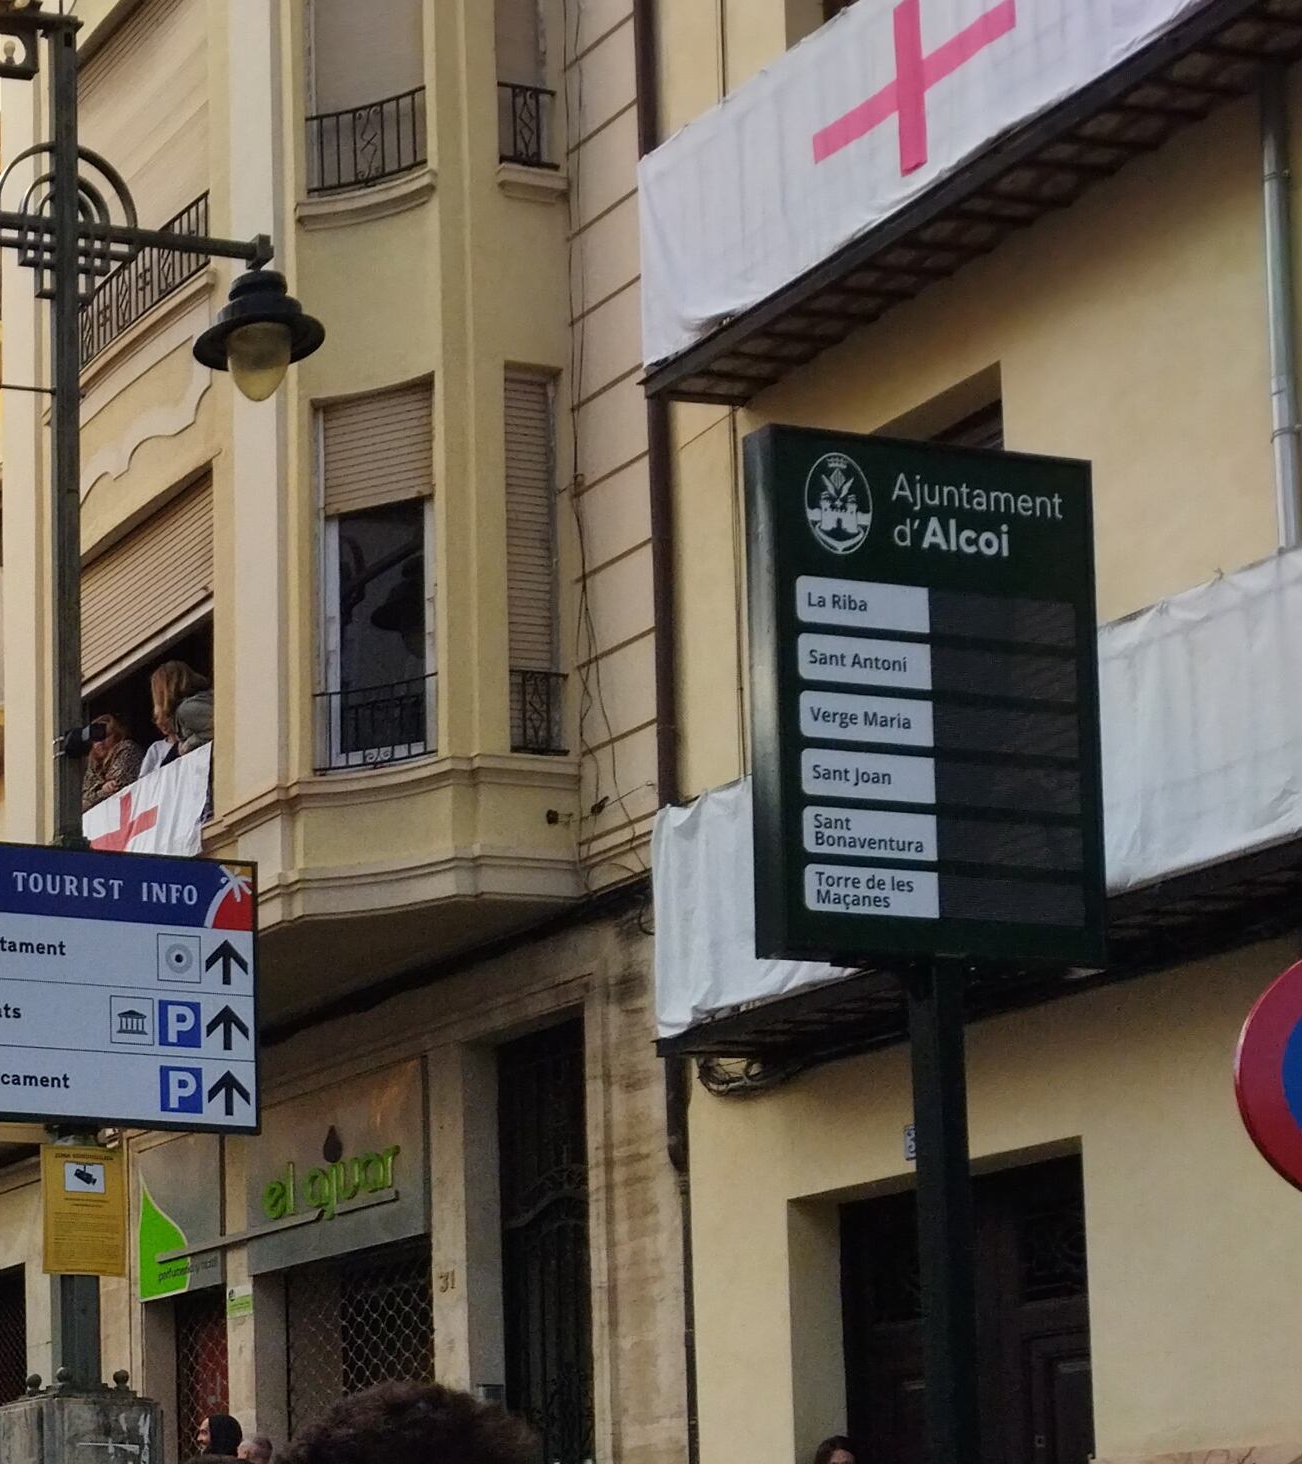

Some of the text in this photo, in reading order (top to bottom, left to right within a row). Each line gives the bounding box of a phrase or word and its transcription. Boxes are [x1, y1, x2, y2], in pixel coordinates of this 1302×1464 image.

[891, 472, 1064, 520] Ajuntament
[893, 517, 1010, 557] d'Alcoi
[806, 592, 868, 612] La Riba
[809, 650, 846, 668] Sant
[810, 706, 912, 730] Verge Maria
[812, 764, 892, 787] Sant Joan
[813, 814, 852, 831] Sant
[814, 831, 924, 853] Bonaventura
[12, 871, 198, 905] TOURIST INFO
[815, 871, 914, 892] Torre de les
[816, 888, 891, 911] Maçanes
[167, 1005, 196, 1042] P
[168, 1070, 197, 1108] P
[261, 1144, 401, 1221] el ajuar
[438, 1269, 456, 1293] 31
